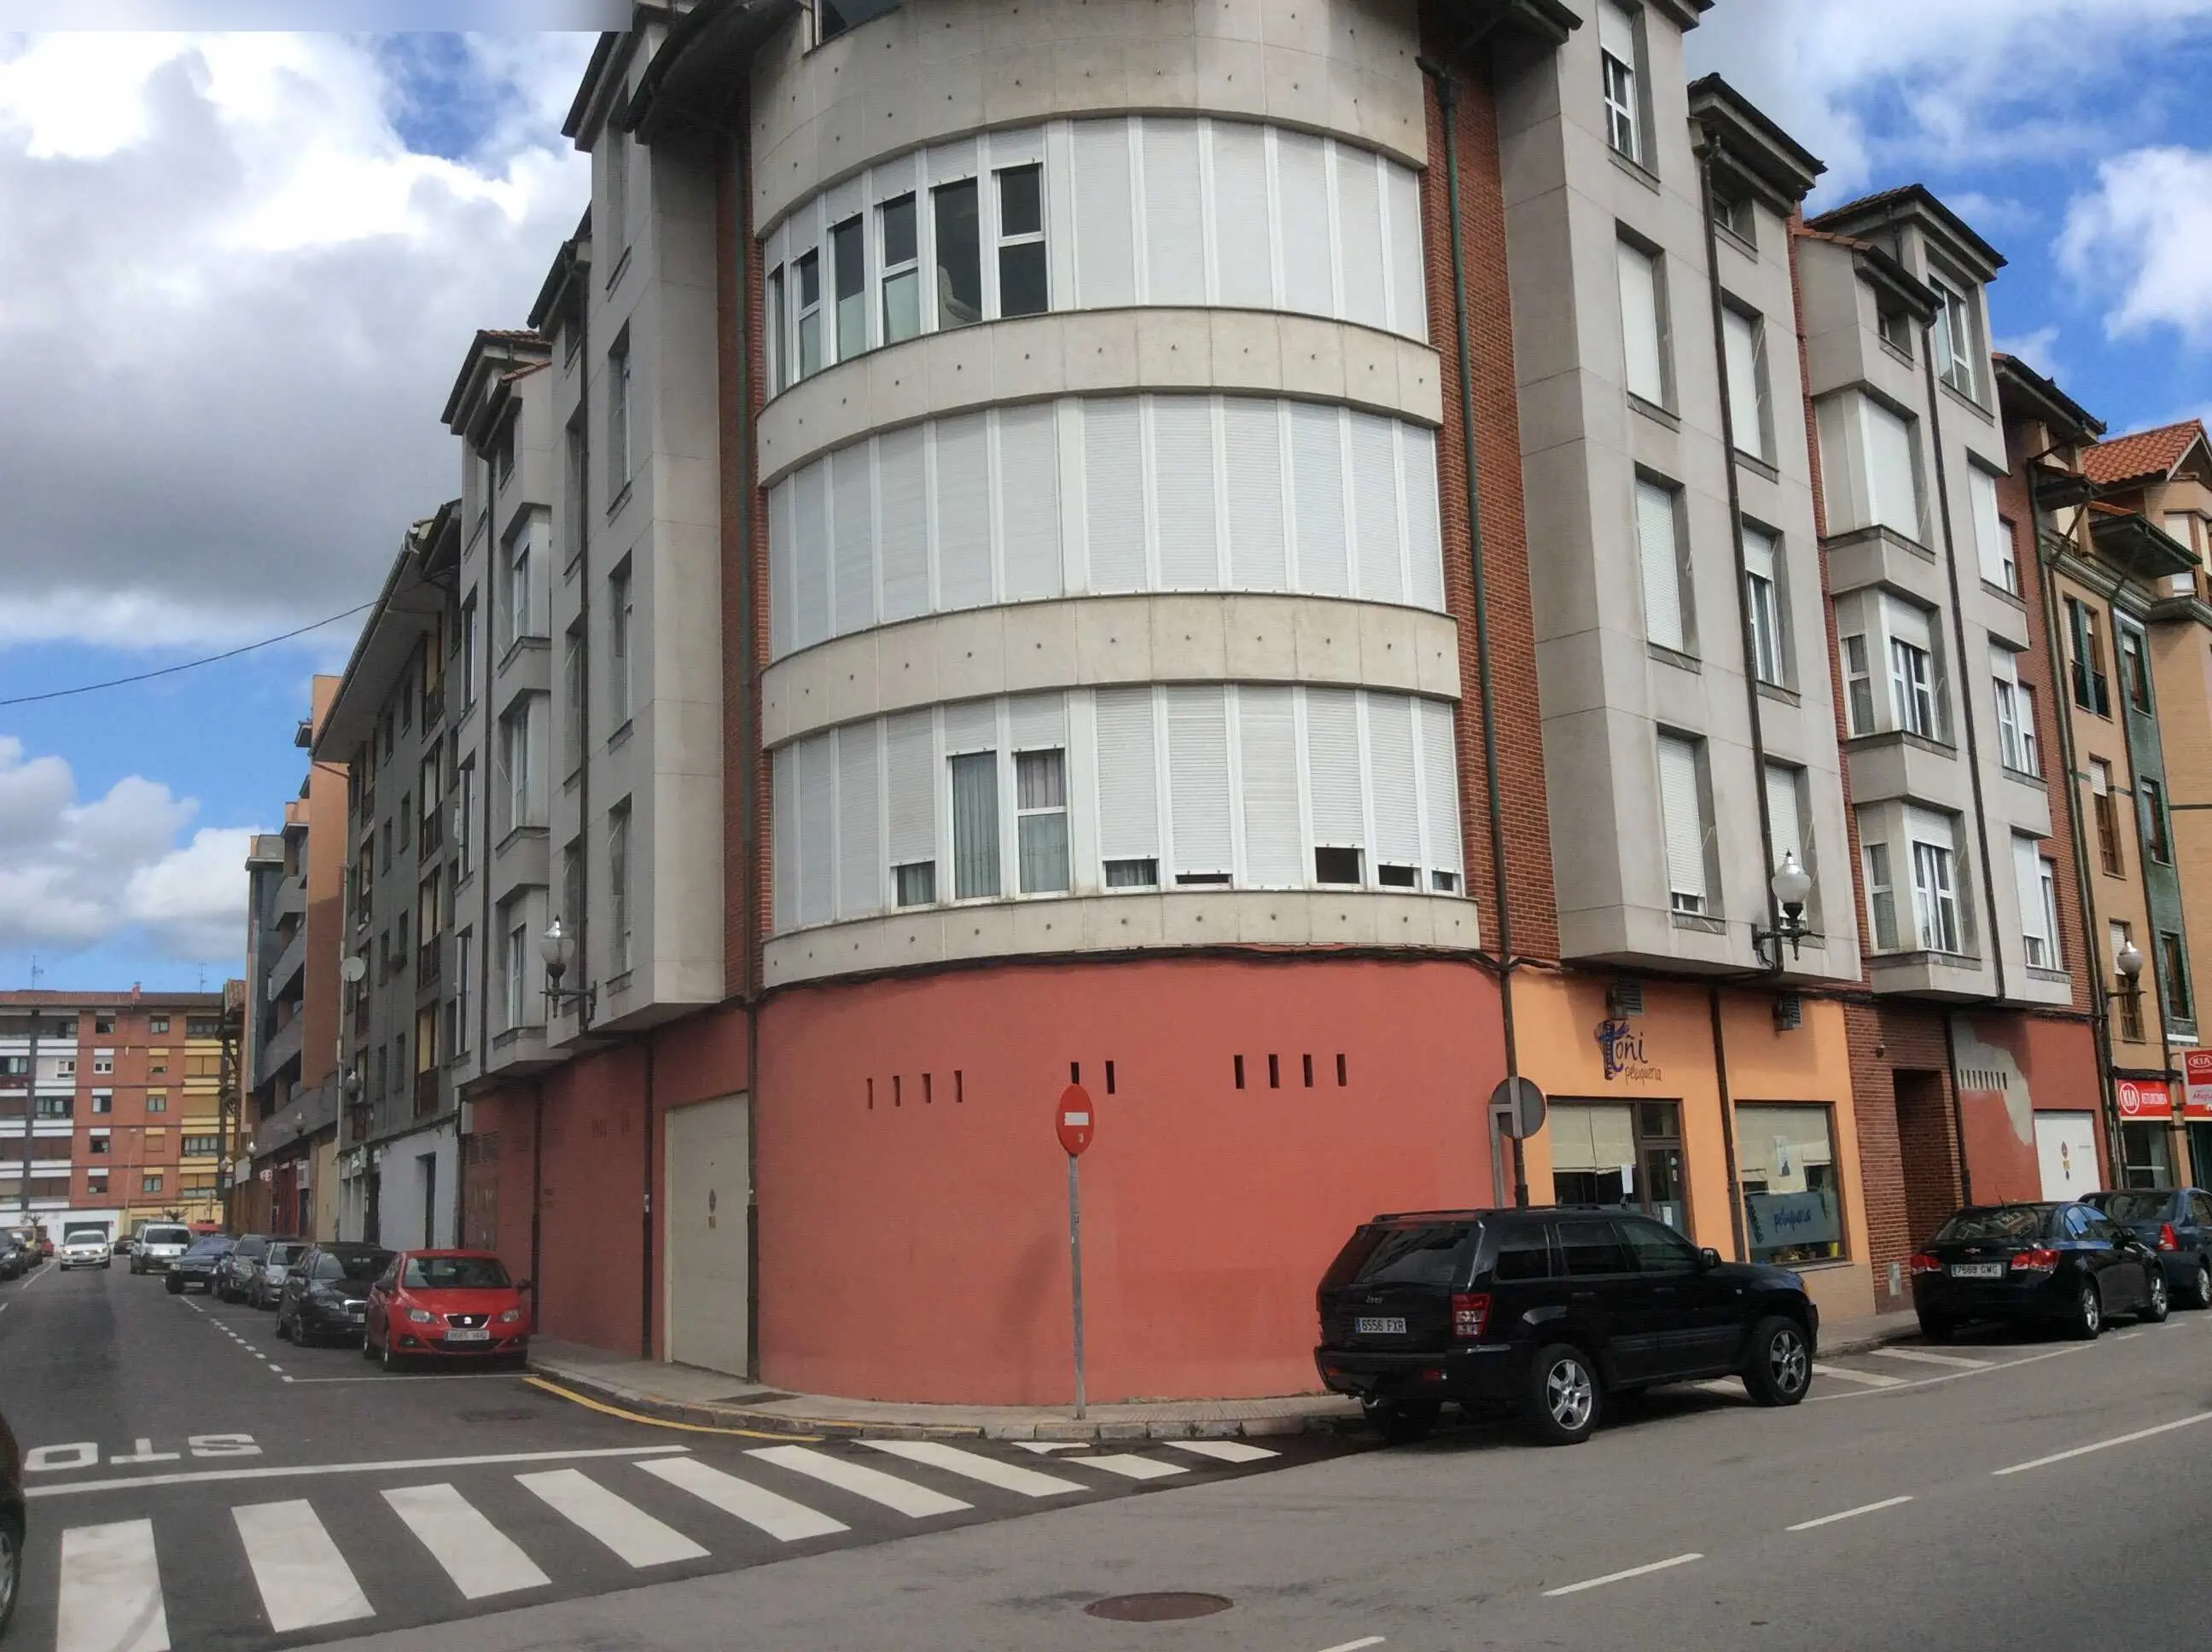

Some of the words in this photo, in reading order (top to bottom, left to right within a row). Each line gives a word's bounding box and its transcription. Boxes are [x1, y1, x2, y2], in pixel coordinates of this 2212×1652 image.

[2122, 1090, 2138, 1107] KIA
[1387, 1319, 1404, 1332] FXR
[24, 1434, 263, 1471] STO
